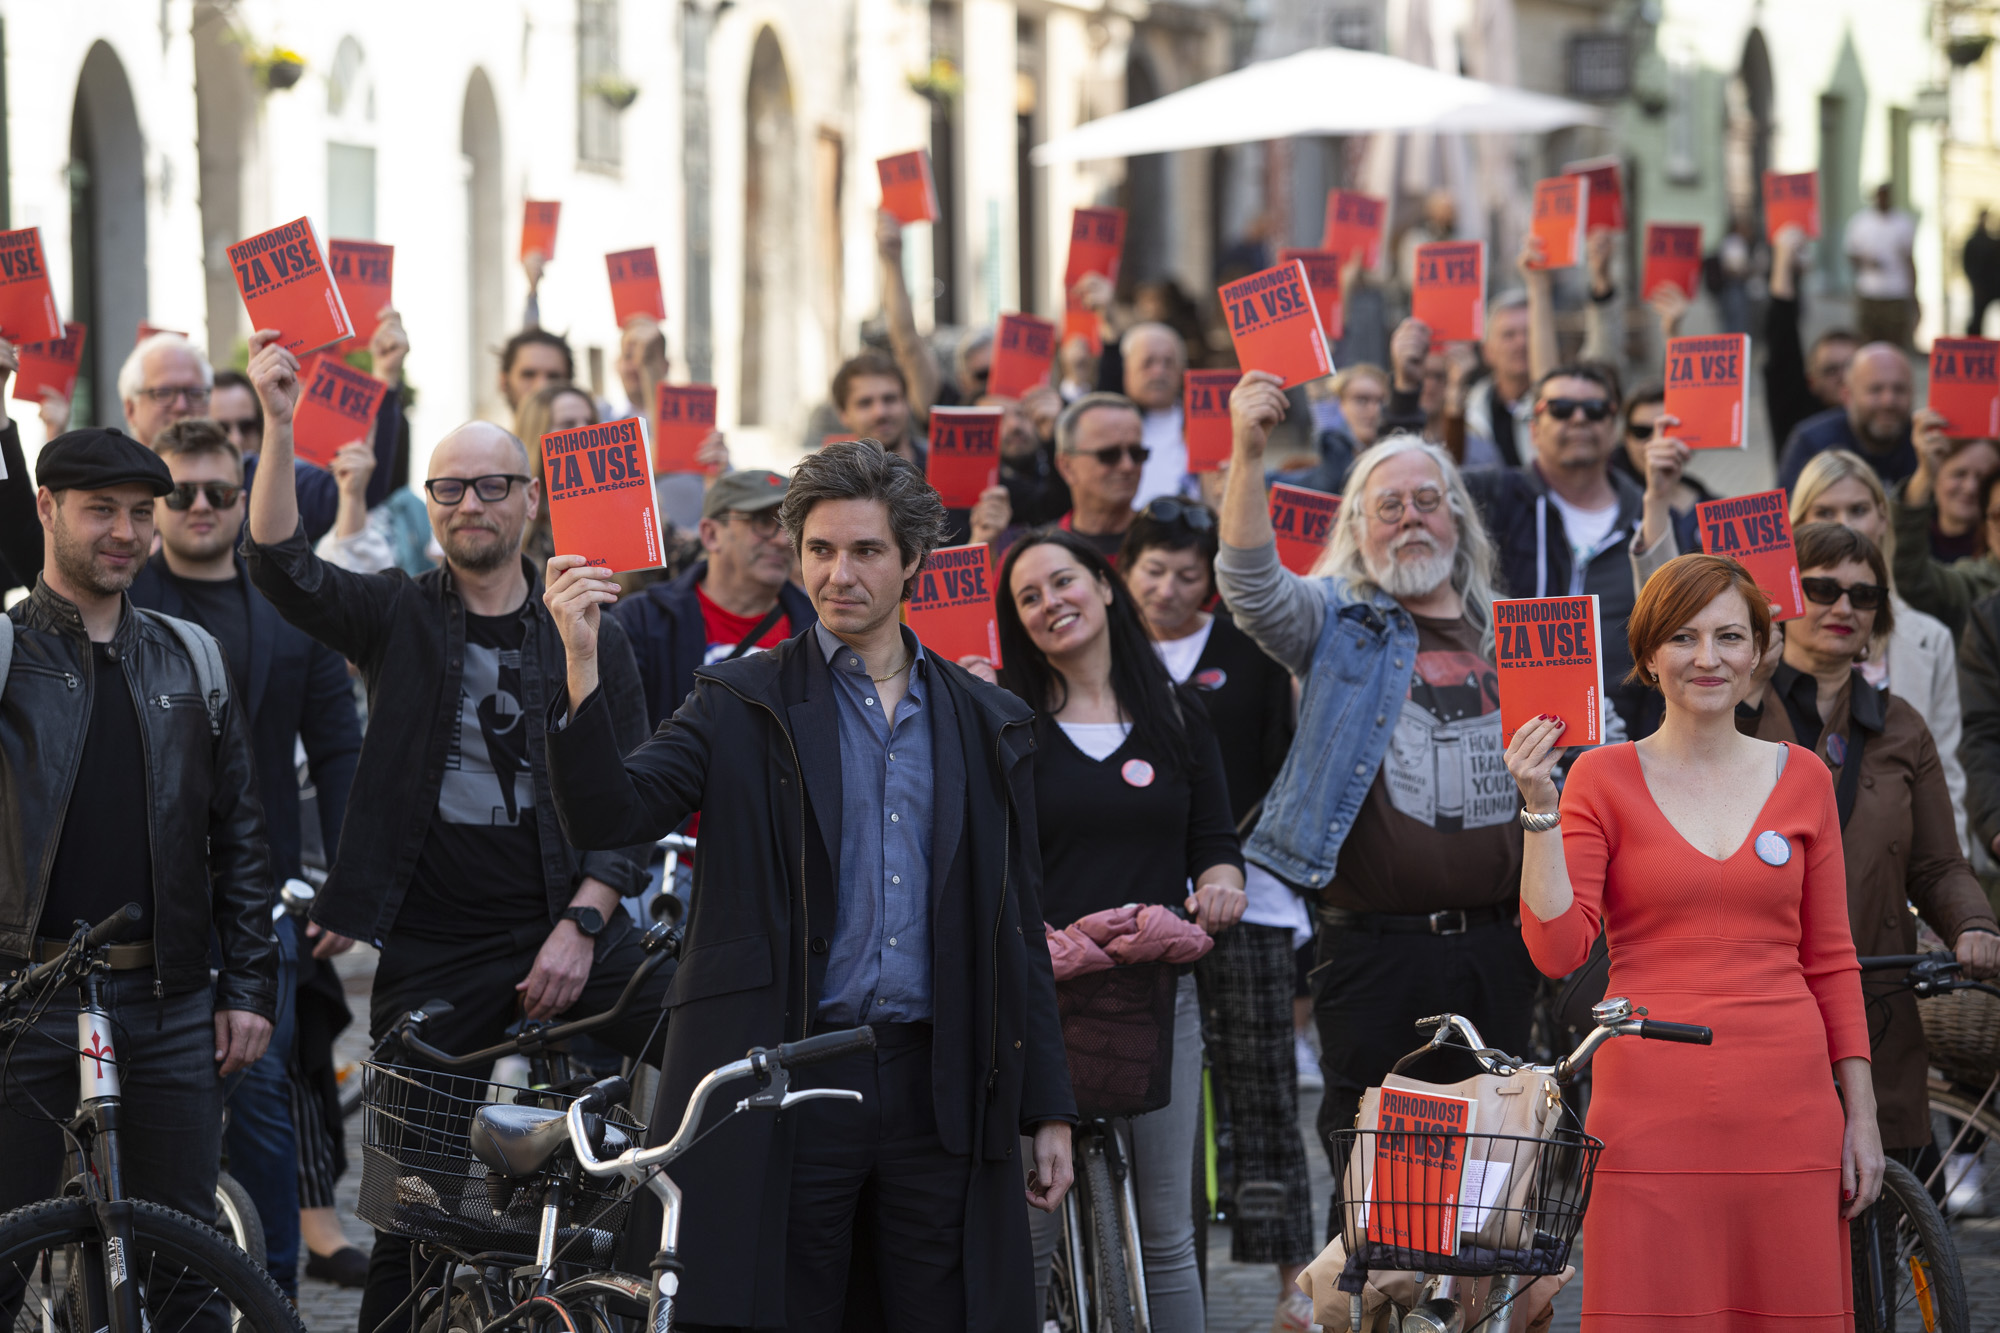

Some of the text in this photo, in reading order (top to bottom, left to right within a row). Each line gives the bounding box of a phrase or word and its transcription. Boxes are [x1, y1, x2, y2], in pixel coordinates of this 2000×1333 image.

[231, 221, 307, 264] PRIHODNOST
[237, 258, 271, 293] ZA
[1224, 266, 1298, 303] PRIHODNOST
[1229, 299, 1260, 330] ZA
[1671, 357, 1693, 381] ZA
[545, 422, 638, 457] PRIHODNOST
[548, 444, 644, 492] ZA VSE,
[553, 478, 645, 501] NE LE ZA PEŠČICO
[1703, 494, 1782, 522] PRIHODNOST
[1707, 521, 1741, 553] ZA
[584, 558, 607, 568] VICA
[911, 573, 939, 604] ZA
[1497, 601, 1588, 624] PRIHODNOST
[1498, 622, 1591, 660] ZA VSE,
[1546, 657, 1592, 667] PEŠČICO
[1383, 1092, 1464, 1124] PRIHODNOST
[1379, 1115, 1406, 1153] ZA
